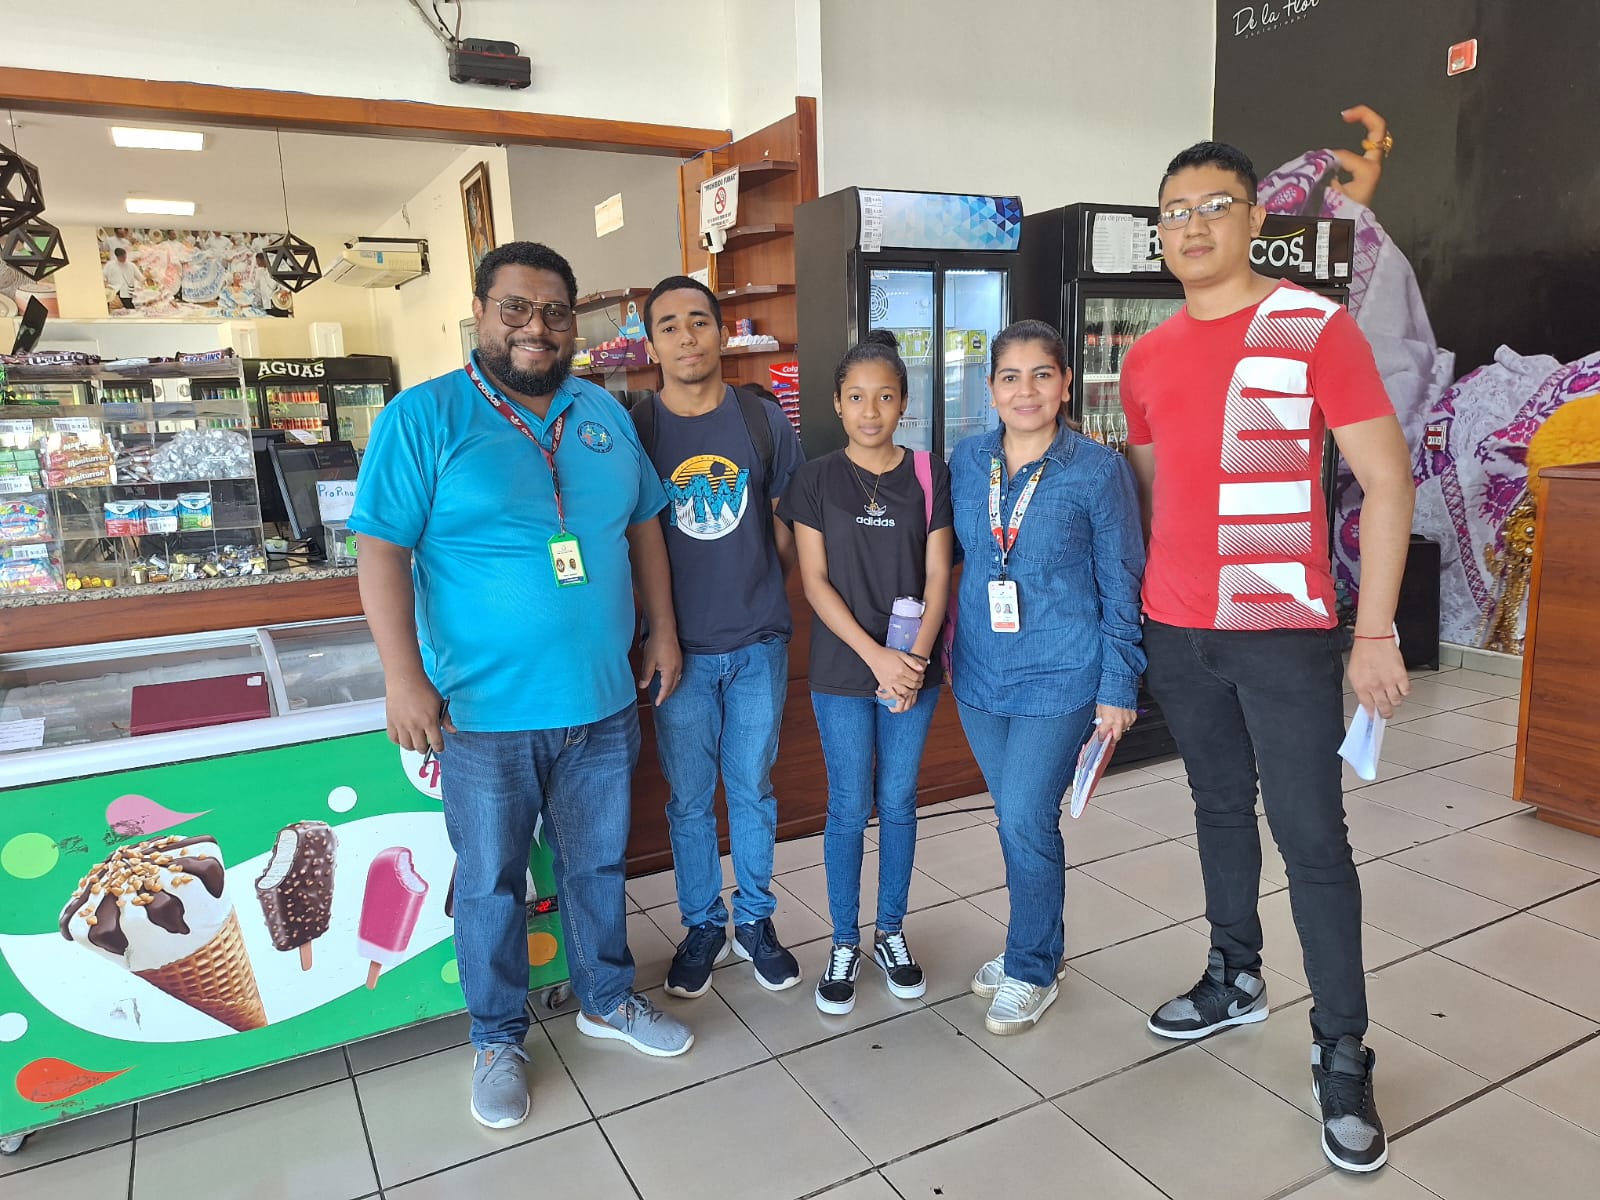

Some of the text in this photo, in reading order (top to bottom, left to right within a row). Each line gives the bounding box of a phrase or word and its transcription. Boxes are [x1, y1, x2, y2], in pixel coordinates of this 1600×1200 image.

[1232, 7, 1257, 36] De
[1261, 3, 1281, 25] la
[257, 361, 326, 378] AGUAS
[855, 516, 896, 527] adidas
